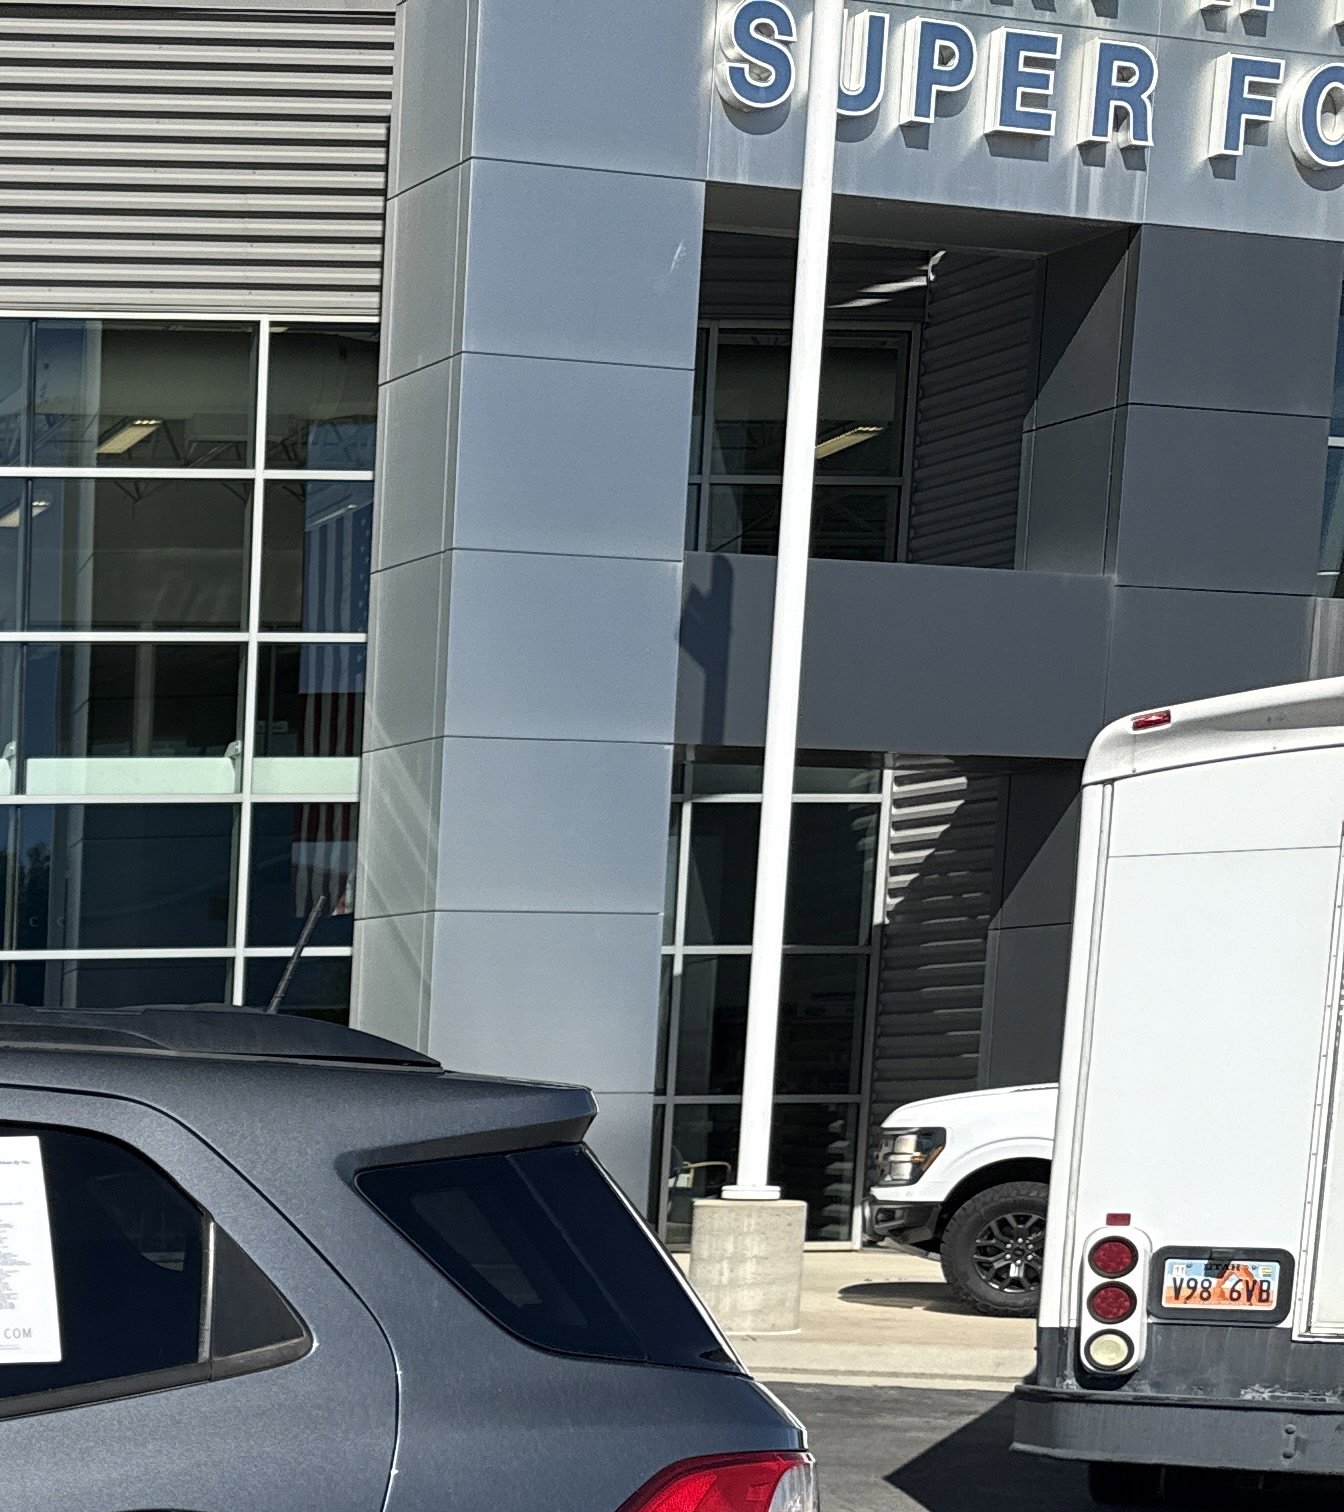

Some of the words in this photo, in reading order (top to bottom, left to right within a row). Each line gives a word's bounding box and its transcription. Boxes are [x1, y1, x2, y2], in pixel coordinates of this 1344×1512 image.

[716, 0, 1157, 148] SUPER
[1172, 1277, 1213, 1303] V98
[1229, 1279, 1272, 1304] 6VB
